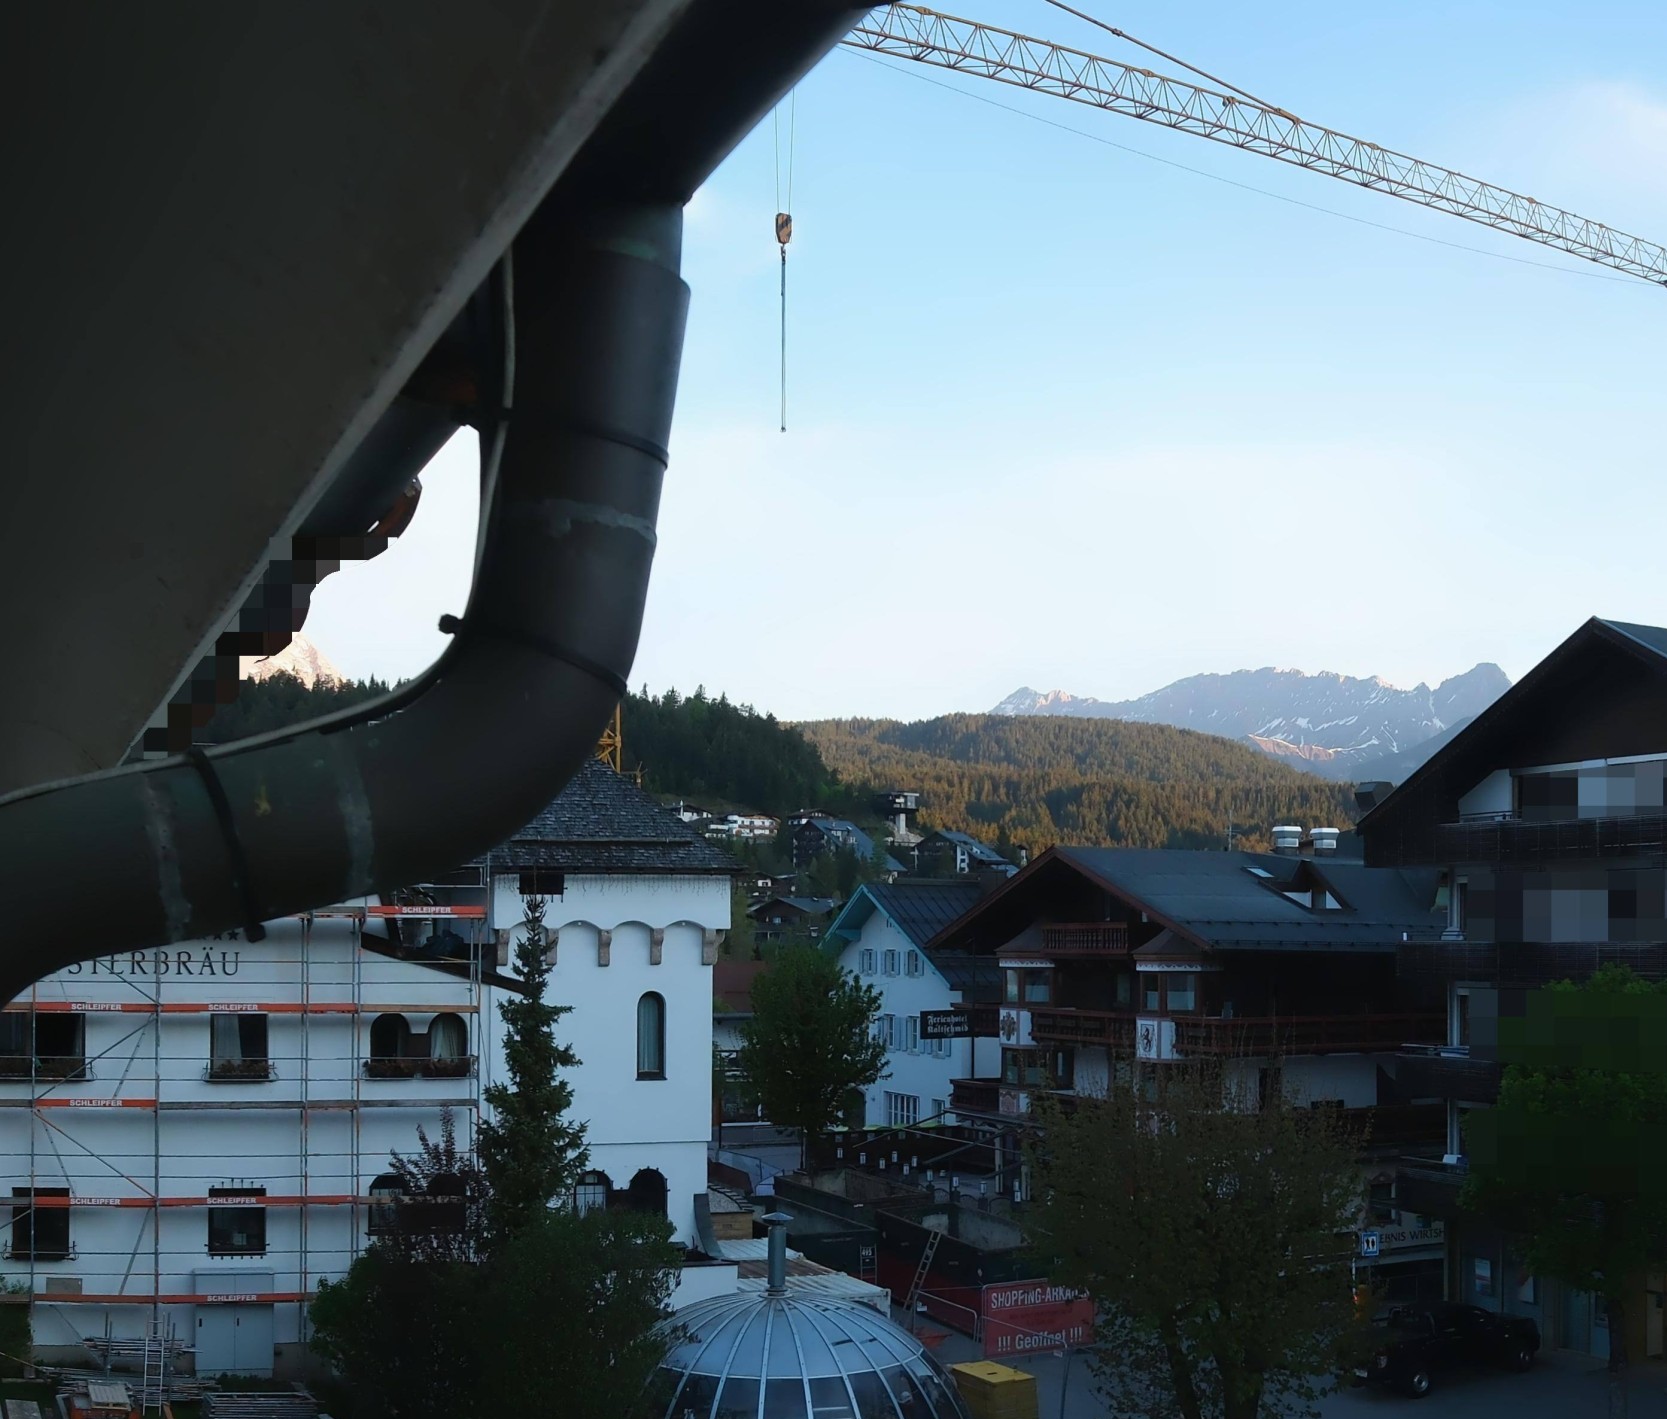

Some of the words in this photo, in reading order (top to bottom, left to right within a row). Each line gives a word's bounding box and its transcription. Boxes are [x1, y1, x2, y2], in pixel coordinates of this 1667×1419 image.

[71, 1003, 122, 1011] SCHLEIPFER
[69, 1099, 123, 1107] SCHLEIPFER
[70, 1197, 121, 1205] SCHLEIPFER
[206, 1197, 257, 1205] SCHLEIPFER
[207, 1294, 258, 1302] SCHLEIPFER
